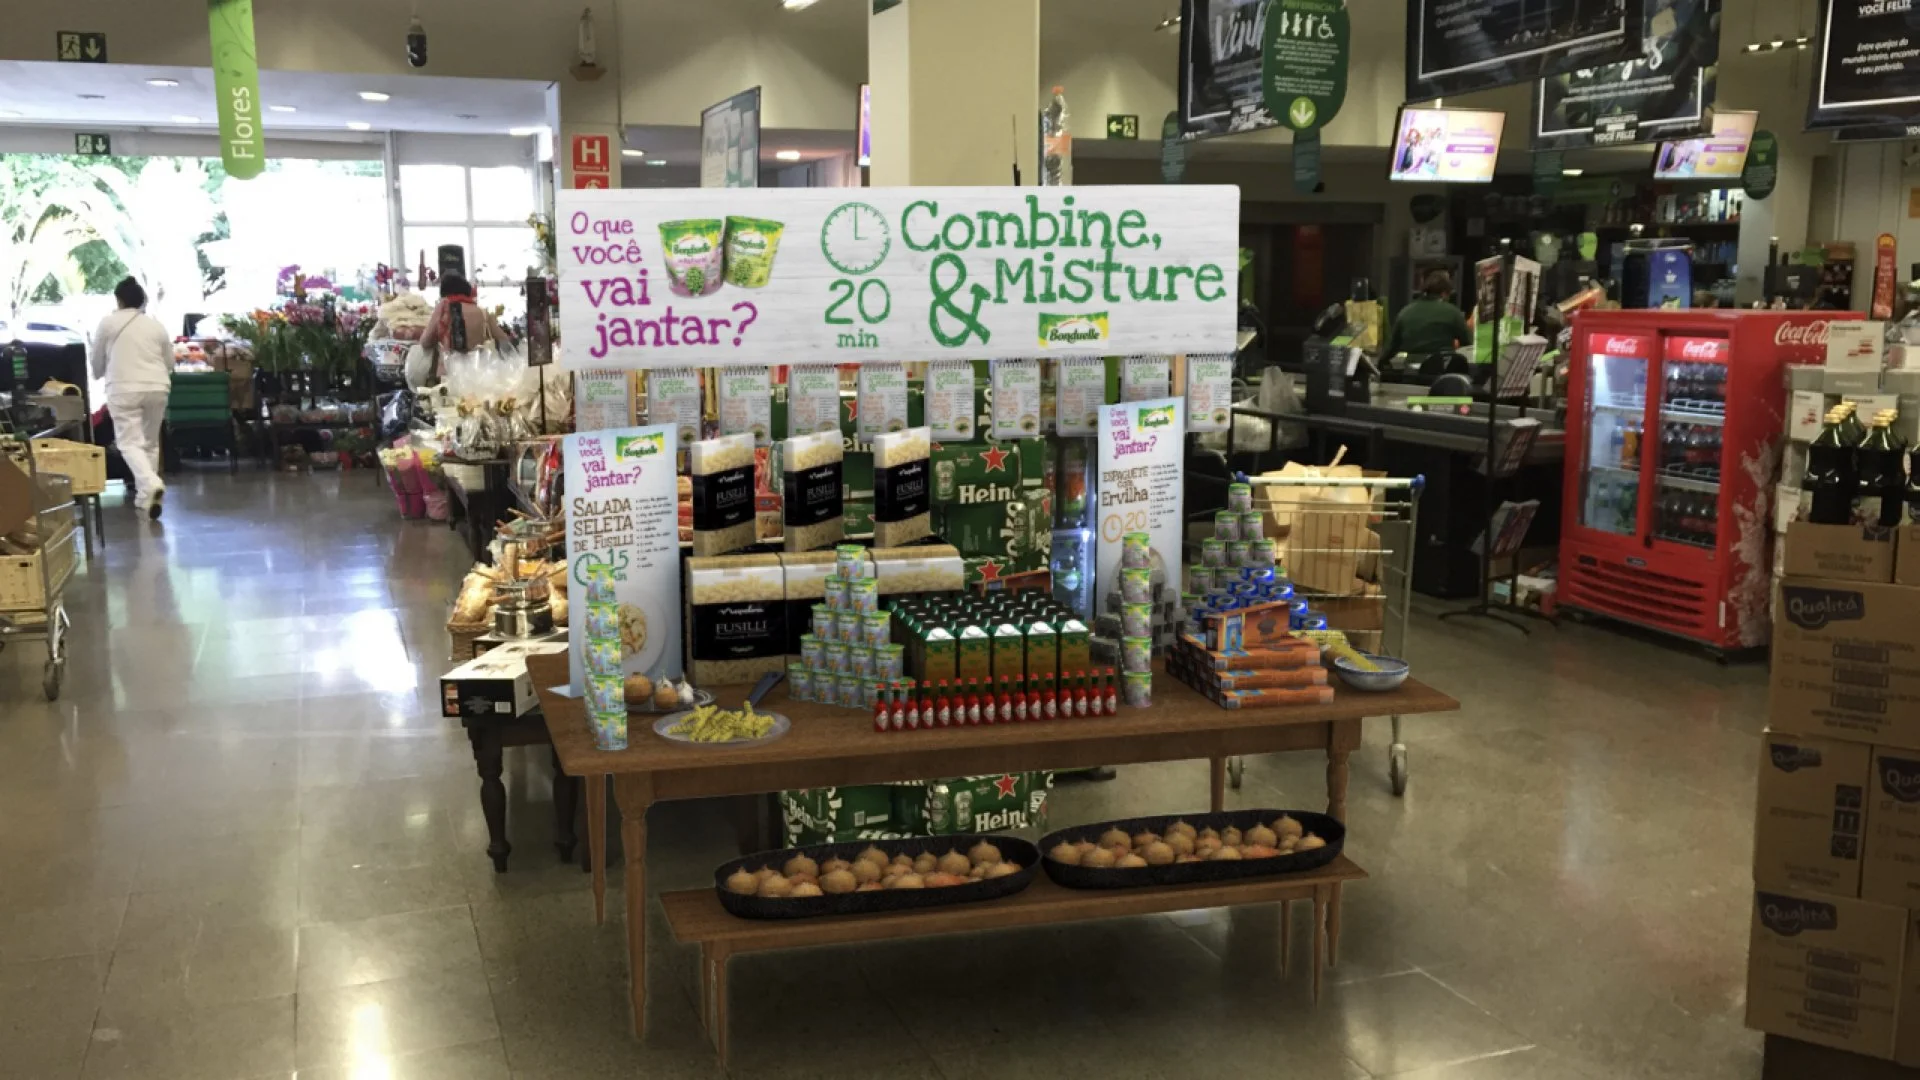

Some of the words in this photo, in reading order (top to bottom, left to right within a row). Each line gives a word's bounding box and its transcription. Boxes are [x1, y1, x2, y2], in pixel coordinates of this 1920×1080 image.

[230, 86, 255, 159] Flores
[581, 139, 601, 163] H
[570, 211, 589, 235] O
[593, 217, 633, 241] que
[901, 194, 1163, 252] Combine,
[573, 238, 642, 265] você
[581, 268, 652, 308] vai
[929, 252, 991, 348] &
[992, 245, 1228, 305] Misture
[823, 277, 892, 325] 20
[589, 300, 759, 359] jantar?
[836, 328, 879, 348] min
[1048, 327, 1101, 344] Bonduelle
[1774, 320, 1830, 346] Coca-Cola
[1606, 337, 1638, 354] Coca-Cola
[1682, 341, 1719, 358] Coca-Cola
[578, 436, 586, 447] O
[586, 438, 601, 449] que
[1112, 427, 1130, 442] vai
[579, 446, 603, 457] você
[1113, 435, 1157, 460] jantar?
[582, 456, 606, 474] vai
[585, 465, 642, 492] jantar?
[1102, 486, 1149, 507] Ervilha
[573, 515, 634, 537] SELETA
[1125, 510, 1147, 531] 20
[573, 539, 588, 553] DE
[608, 548, 630, 571] 15
[715, 620, 768, 634] FUSILLI
